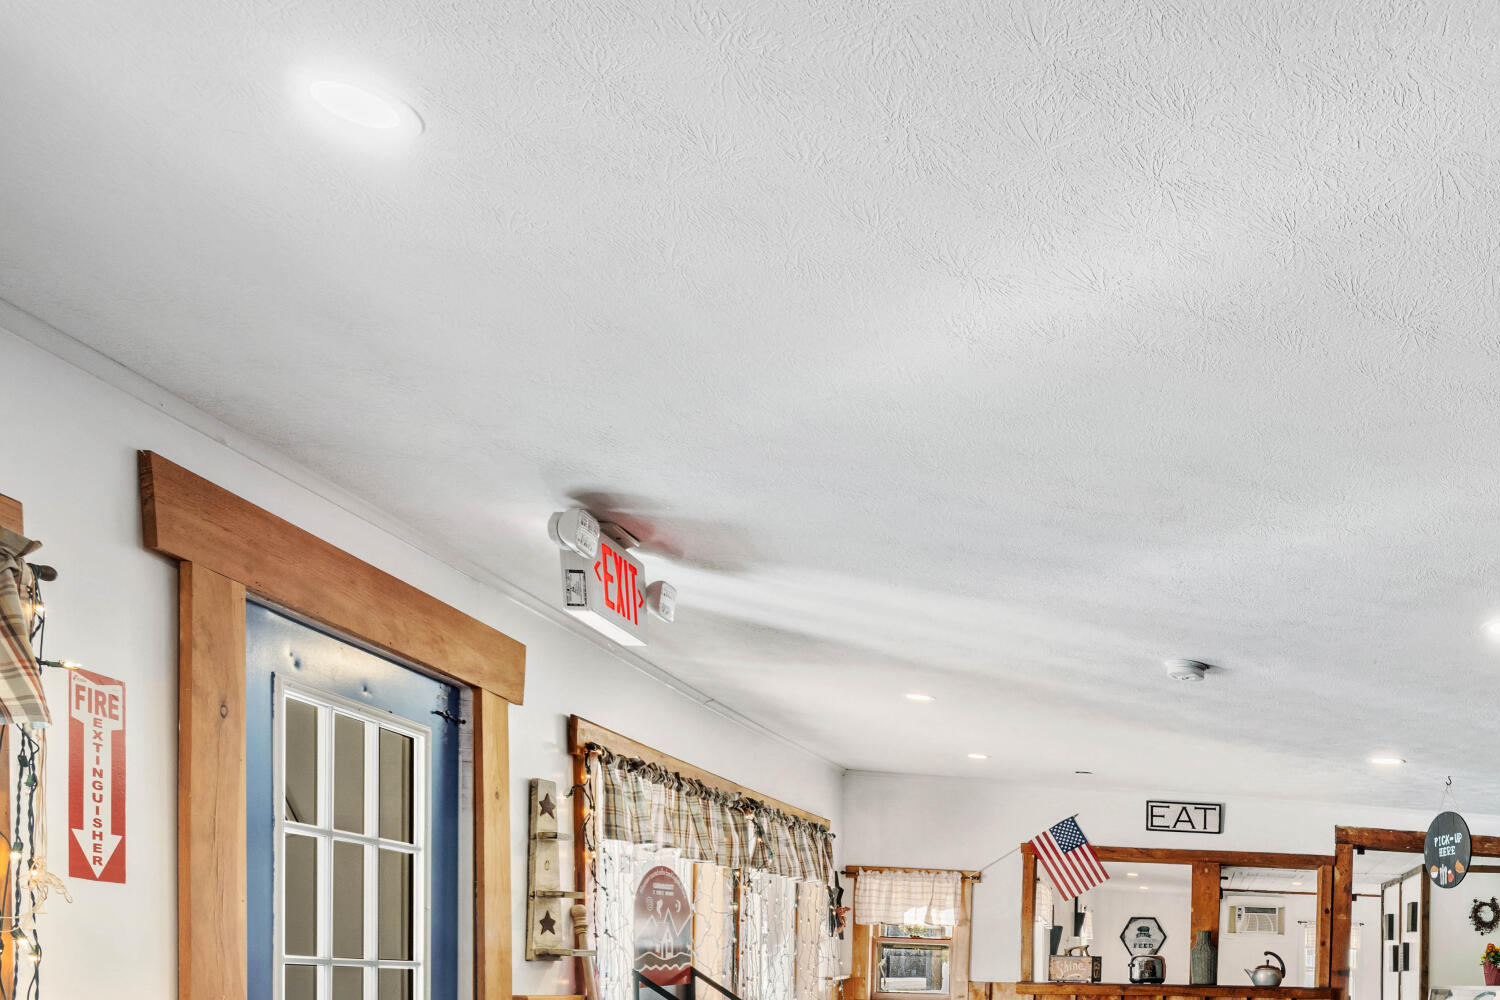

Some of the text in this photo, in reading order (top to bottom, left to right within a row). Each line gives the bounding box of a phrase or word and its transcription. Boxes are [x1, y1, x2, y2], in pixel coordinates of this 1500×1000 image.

[600, 542, 638, 626] EXIT
[75, 683, 119, 721] FIRE
[92, 717, 104, 866] EXTINGUISHER
[1150, 804, 1217, 830] EAT
[1434, 833, 1462, 847] PICK-UP
[1438, 845, 1456, 857] HERE
